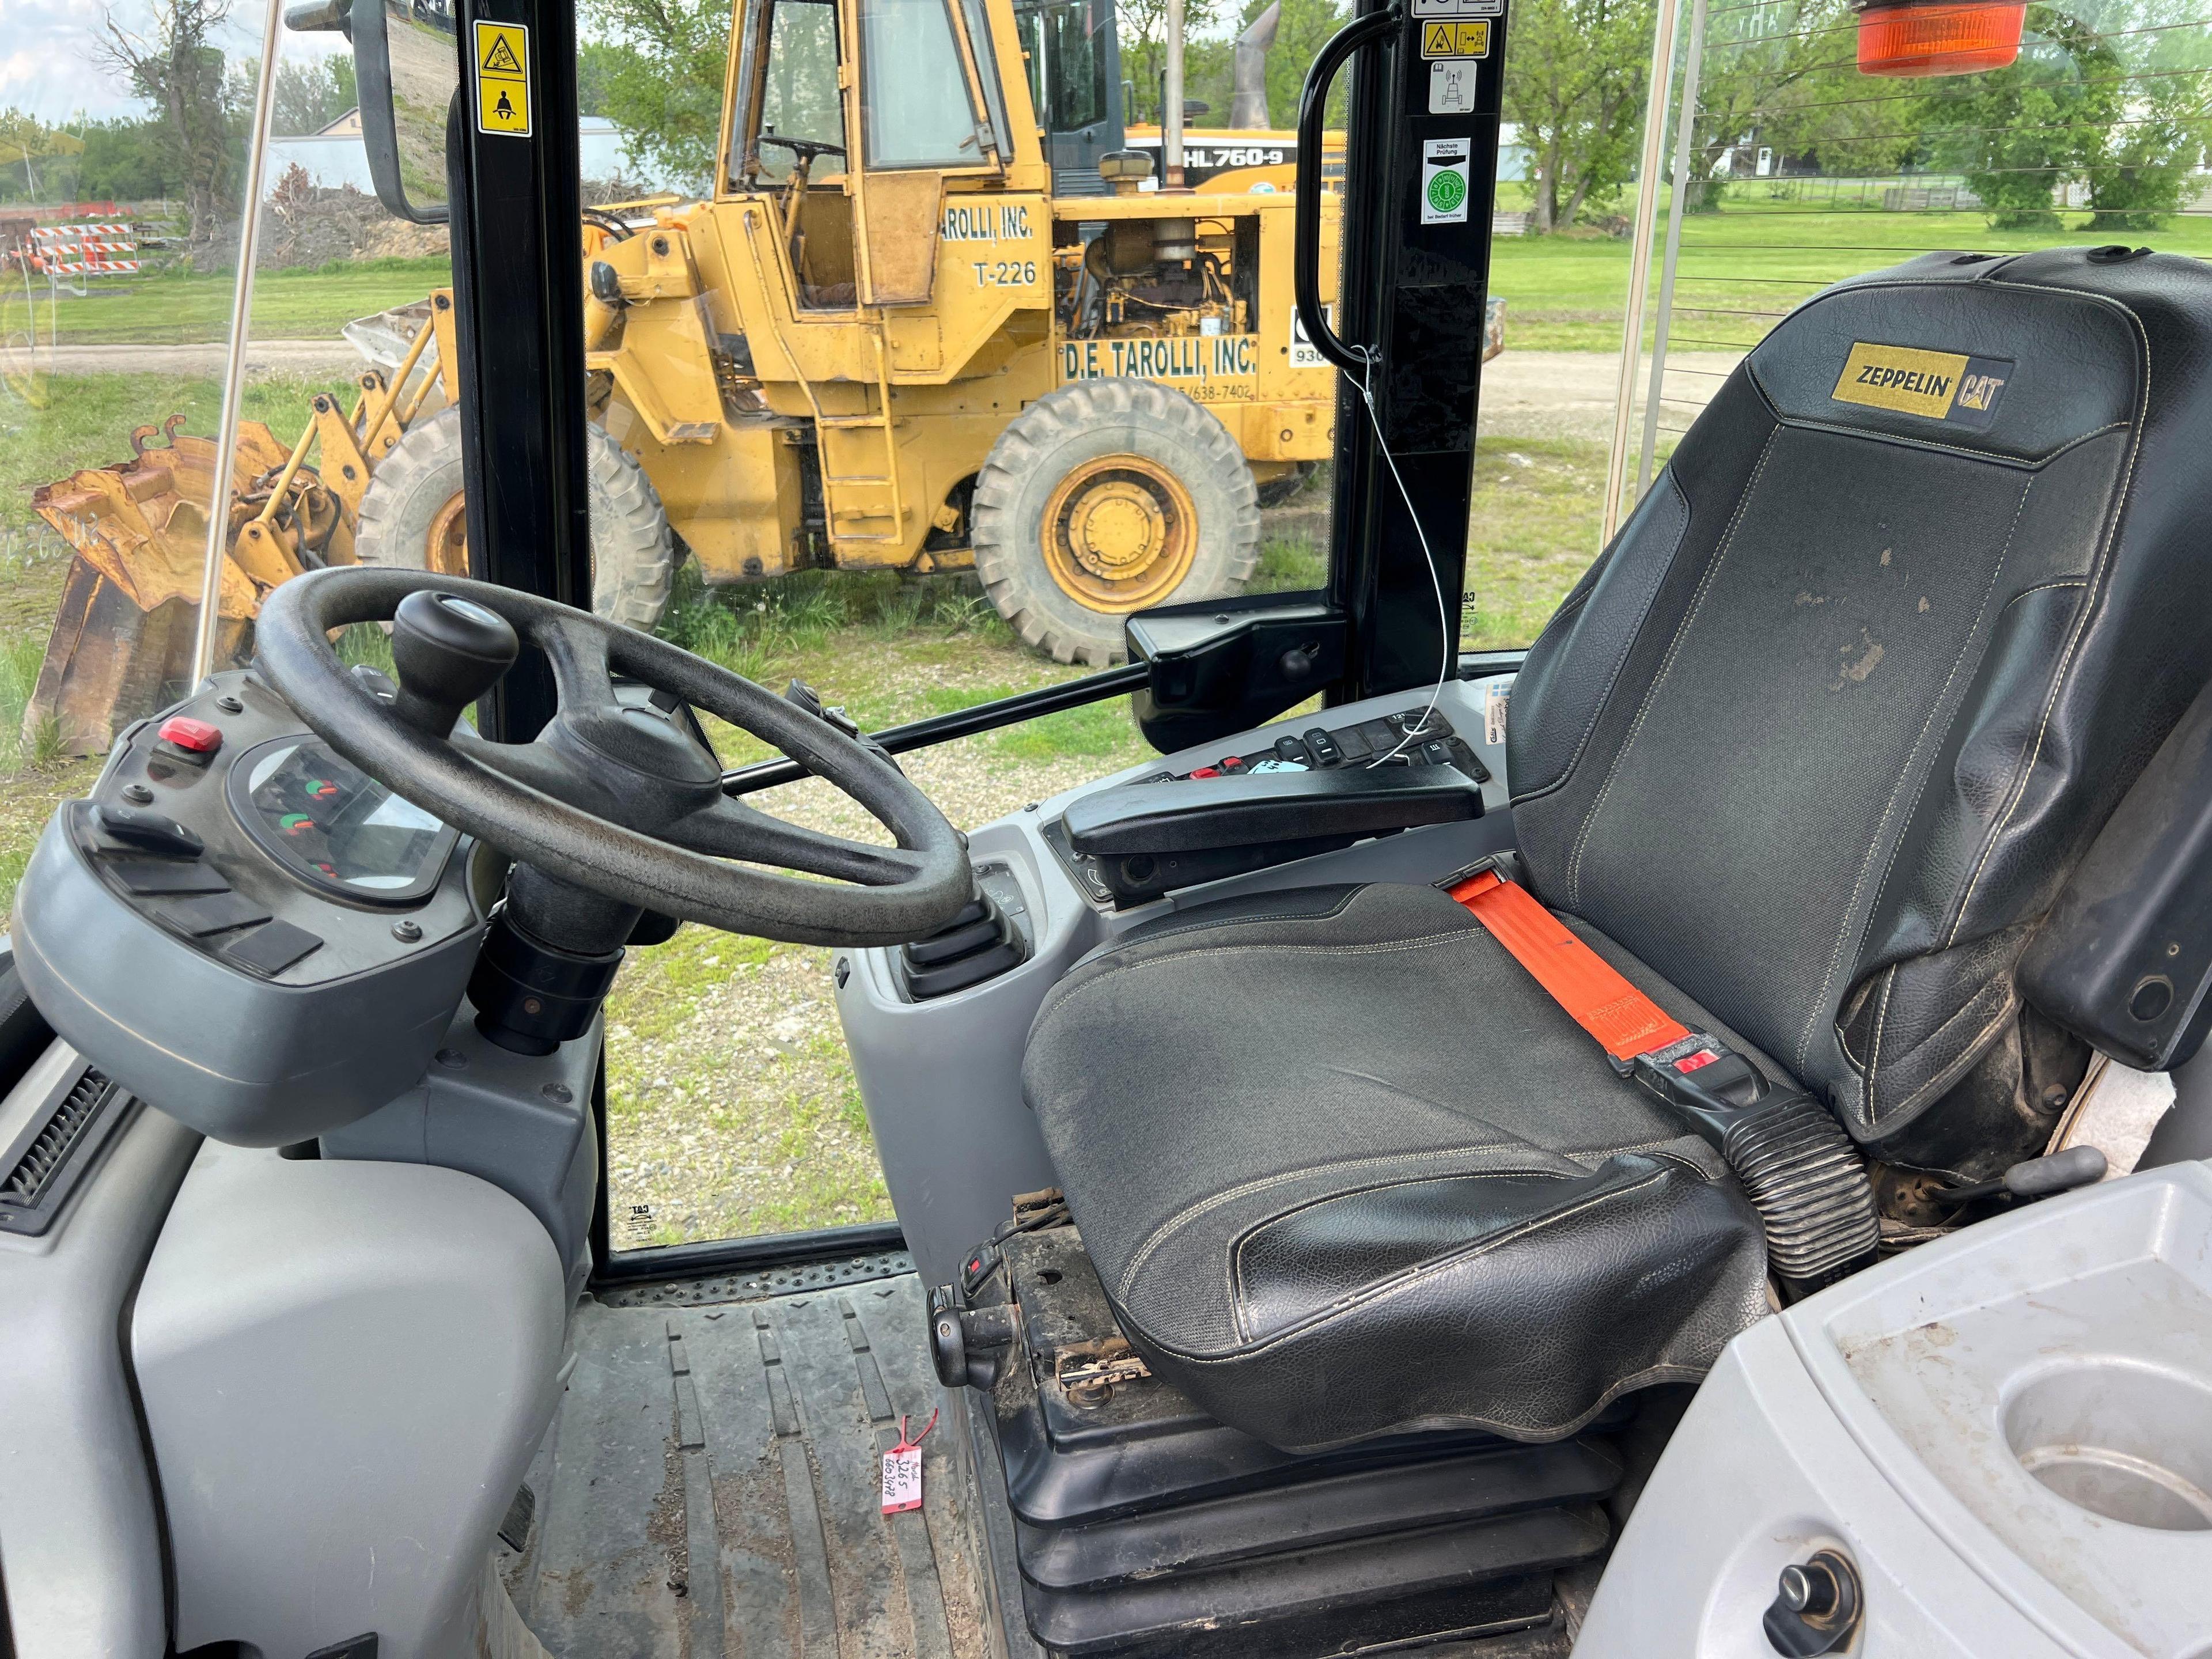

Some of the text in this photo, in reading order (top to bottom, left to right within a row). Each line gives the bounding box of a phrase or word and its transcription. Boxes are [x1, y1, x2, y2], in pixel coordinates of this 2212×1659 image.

[1184, 147, 1283, 168] HL760-9
[1001, 206, 1033, 238] INC.
[972, 261, 1036, 287] T-226
[1066, 338, 1257, 385] D.E. TAROLLI, INC.
[1856, 365, 2005, 411] ZEPPELIN CAT
[896, 1459, 910, 1490] 3265
